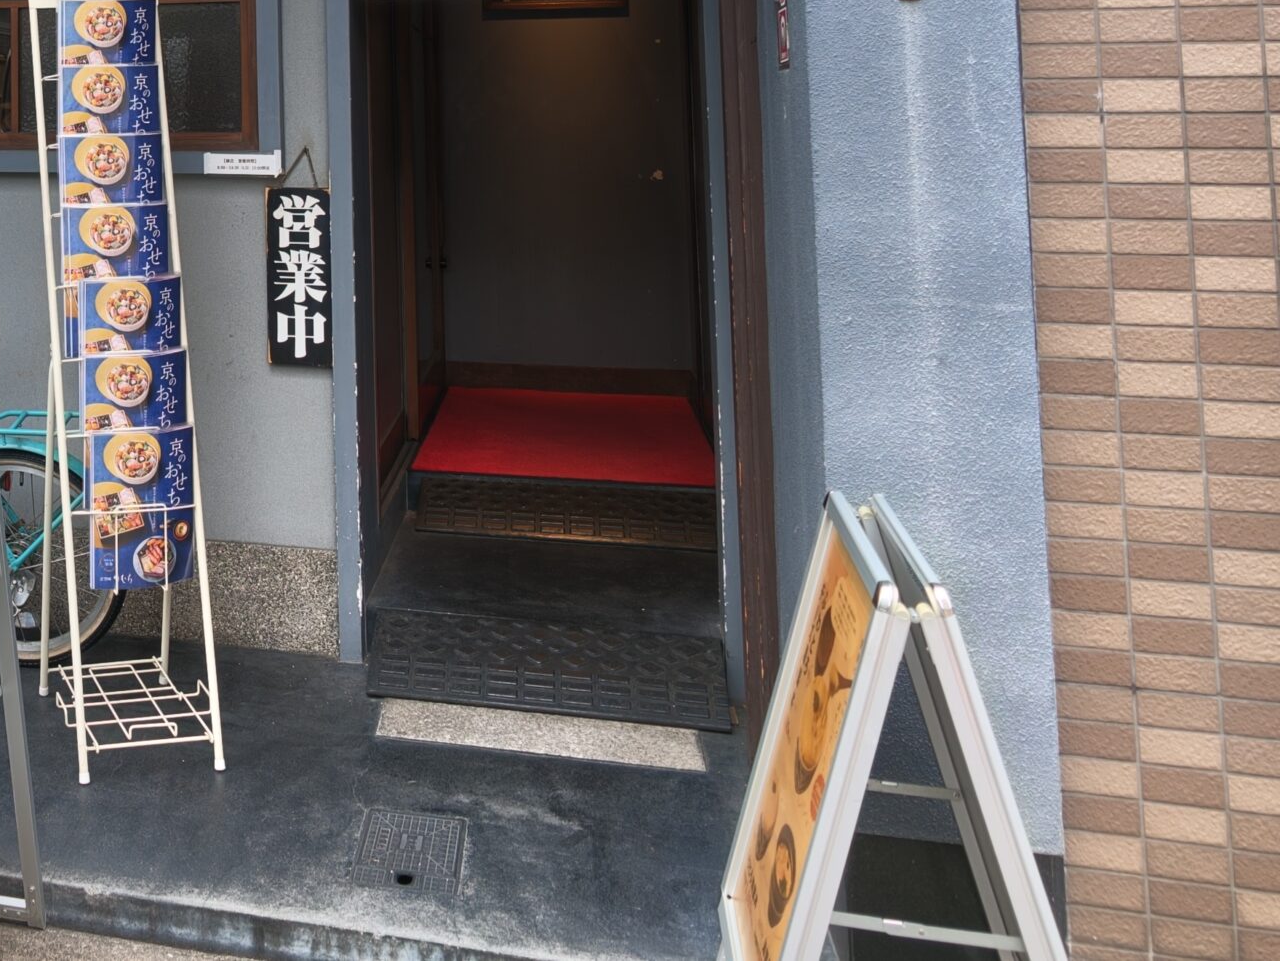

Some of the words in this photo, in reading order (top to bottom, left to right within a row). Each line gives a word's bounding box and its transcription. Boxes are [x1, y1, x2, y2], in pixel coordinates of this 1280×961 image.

[139, 214, 163, 281] 京のおせち
[273, 195, 327, 358] 営業中
[156, 362, 178, 429] 京のおせち
[165, 438, 188, 507] 京のおせち
